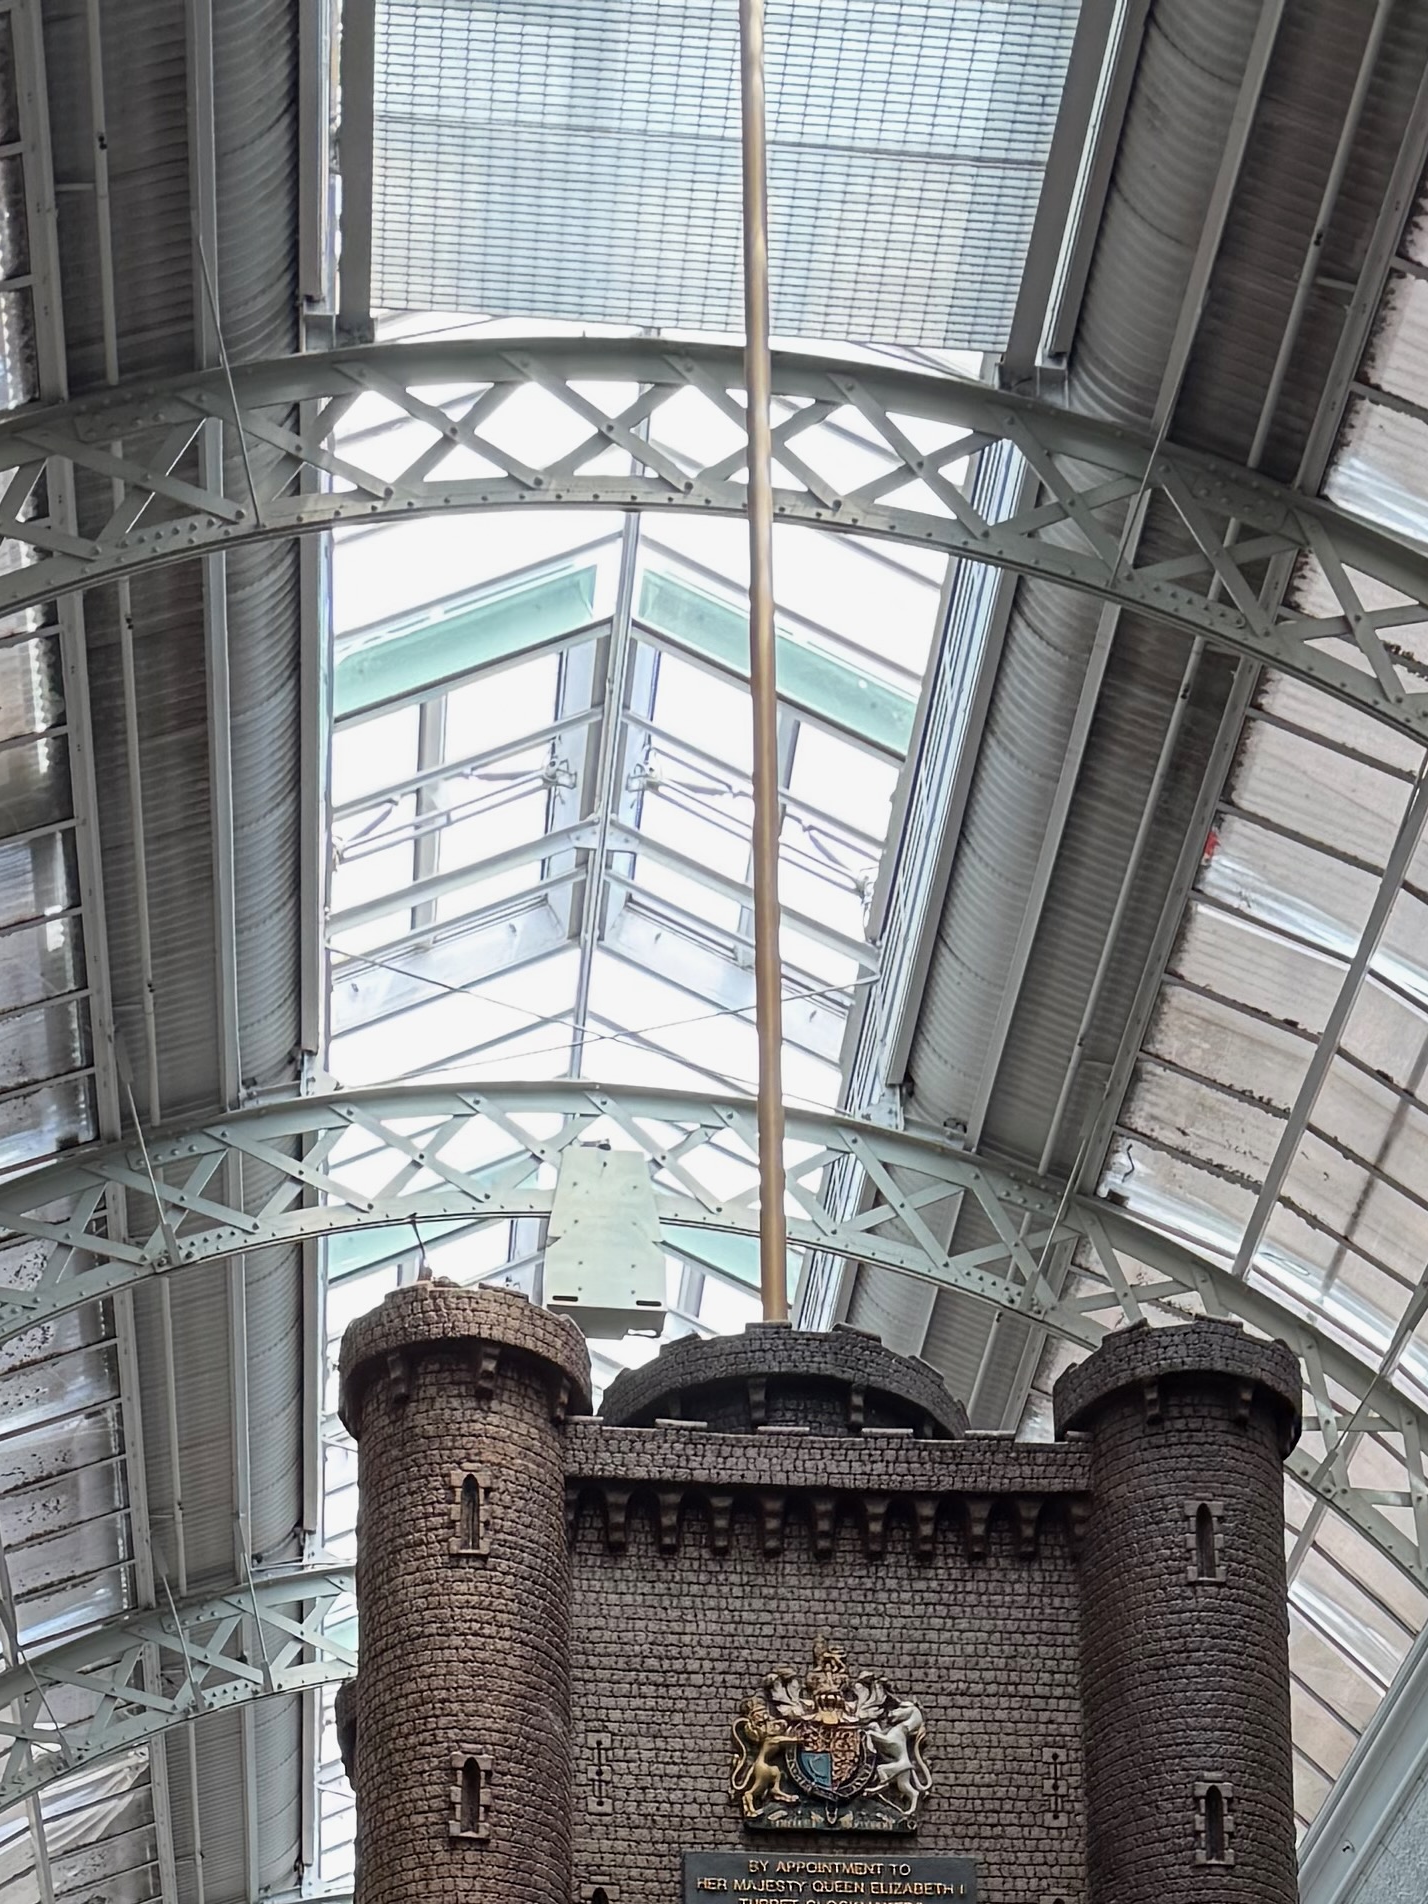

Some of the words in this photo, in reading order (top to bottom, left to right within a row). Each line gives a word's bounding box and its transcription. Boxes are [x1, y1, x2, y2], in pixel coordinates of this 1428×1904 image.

[748, 1859, 769, 1873] BY
[776, 1860, 885, 1876] APPOINTMENT
[890, 1863, 912, 1876] TO
[697, 1877, 728, 1892] HER
[733, 1878, 807, 1893] MAJESTY
[811, 1880, 865, 1895] QUEEN
[870, 1881, 954, 1896] ELIZABETH
